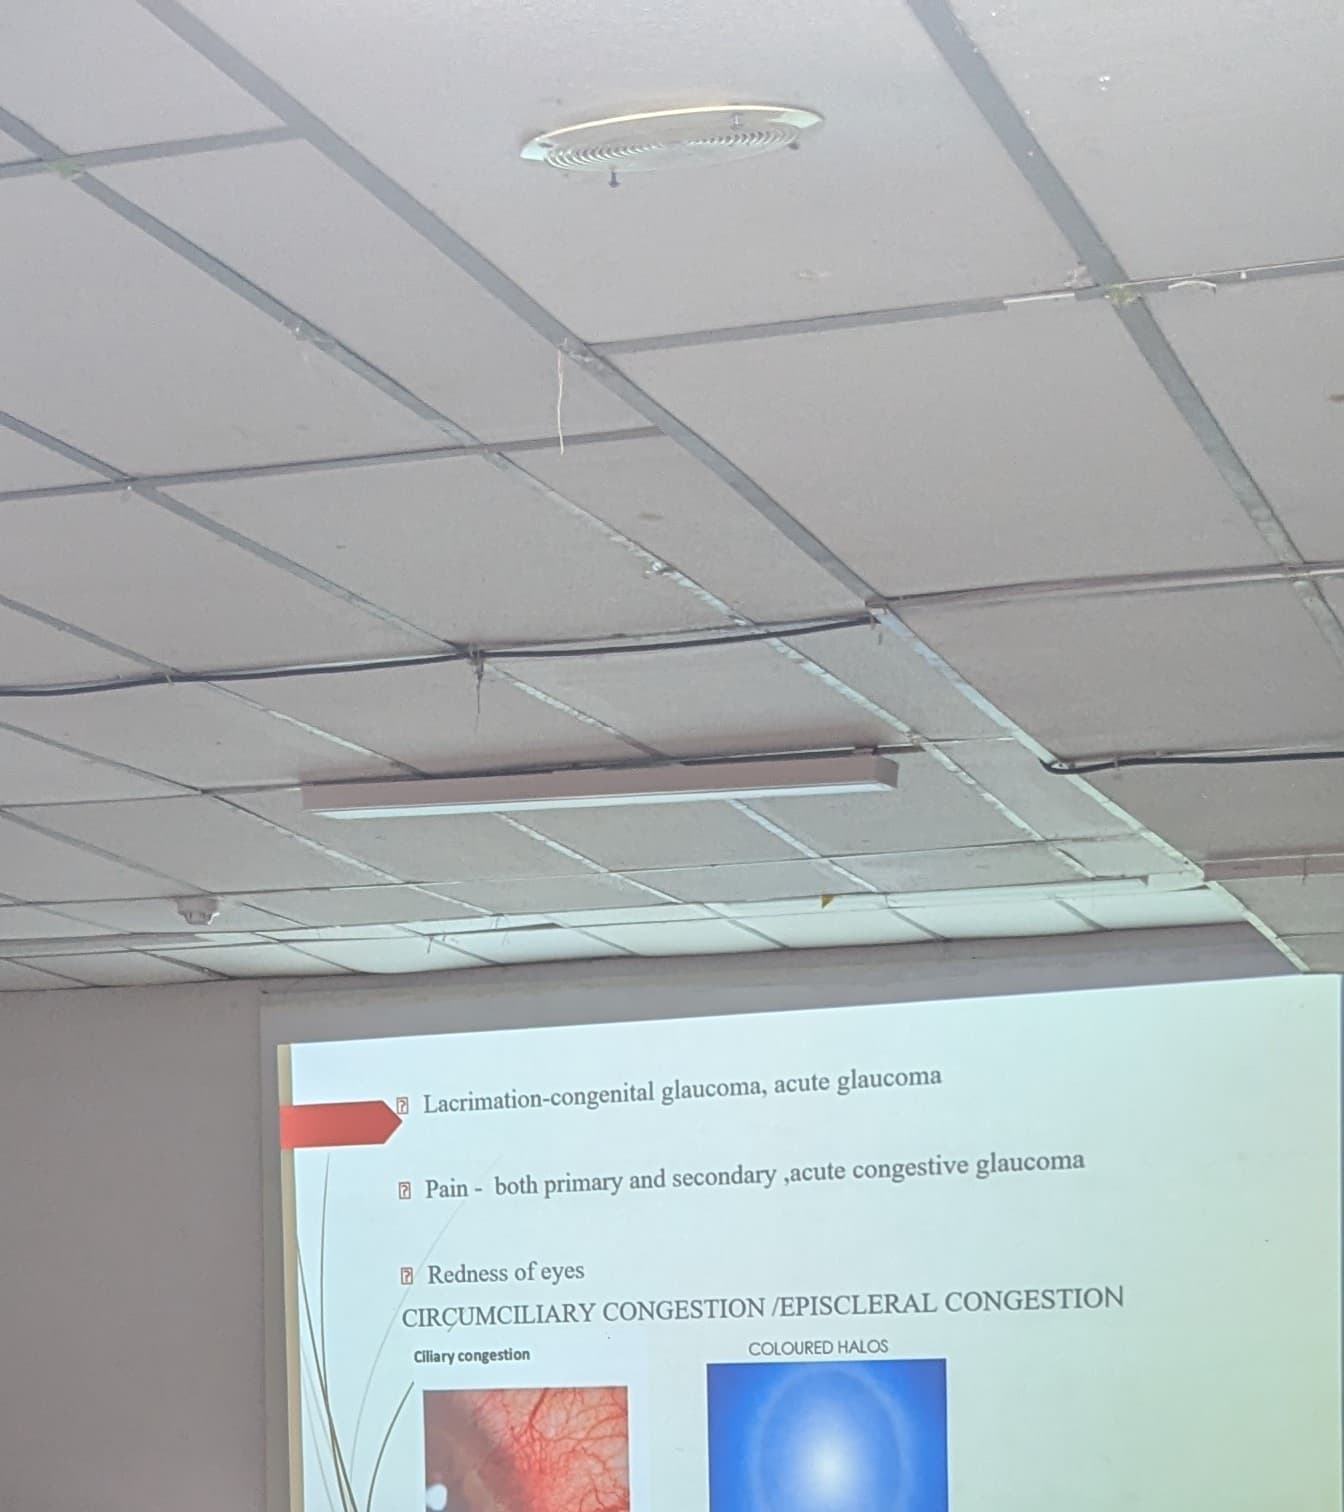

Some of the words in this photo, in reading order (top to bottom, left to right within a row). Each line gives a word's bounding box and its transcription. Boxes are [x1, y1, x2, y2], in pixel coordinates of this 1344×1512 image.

[423, 1080, 655, 1113] Lacrimation-congenital
[661, 1079, 768, 1106] glaucoma,
[774, 1073, 831, 1094] acute
[837, 1068, 943, 1096] glaucoma
[425, 1178, 469, 1199] Pain
[494, 1174, 539, 1196] both
[544, 1172, 624, 1199] primary
[629, 1168, 667, 1190] and
[672, 1164, 777, 1190] secondary
[783, 1161, 846, 1187] ,acute
[852, 1154, 970, 1184] congestive
[975, 1152, 1086, 1180] glaucoma
[427, 1264, 509, 1285] Redness
[514, 1261, 538, 1281] of
[540, 1263, 586, 1286] eyes
[401, 1303, 597, 1328] CIRCUMCILIARY
[602, 1297, 766, 1322] CONGESTION
[770, 1292, 939, 1318] /EPISCLERAL
[944, 1285, 1124, 1313] CONGESTION
[413, 1350, 456, 1365] Ciliary
[457, 1348, 531, 1364] congestion
[748, 1340, 834, 1356] COLOURED
[837, 1339, 889, 1354] HALOS
